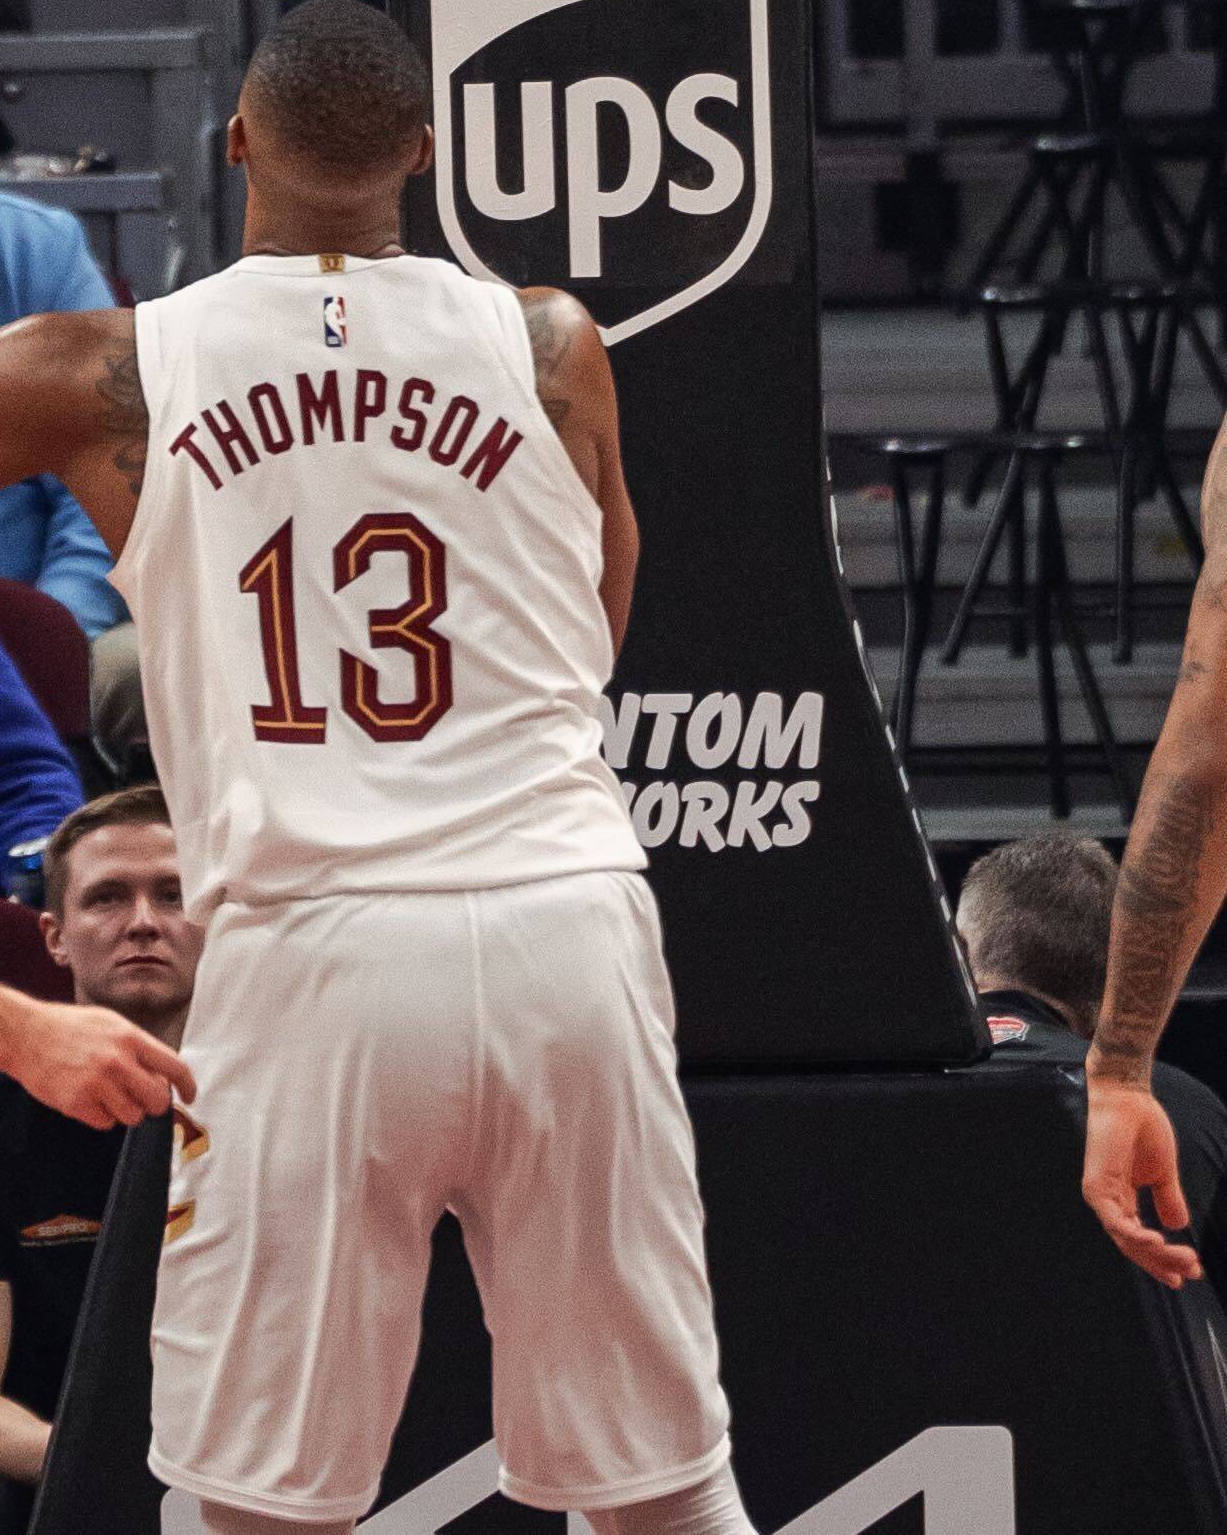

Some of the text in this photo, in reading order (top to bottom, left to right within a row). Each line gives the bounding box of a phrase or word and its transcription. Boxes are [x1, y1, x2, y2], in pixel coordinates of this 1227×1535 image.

[463, 72, 745, 278] ups
[169, 369, 524, 493] THOMPSON
[239, 512, 454, 743] 13
[600, 691, 824, 769] NTOM
[622, 780, 821, 853] ORKS
